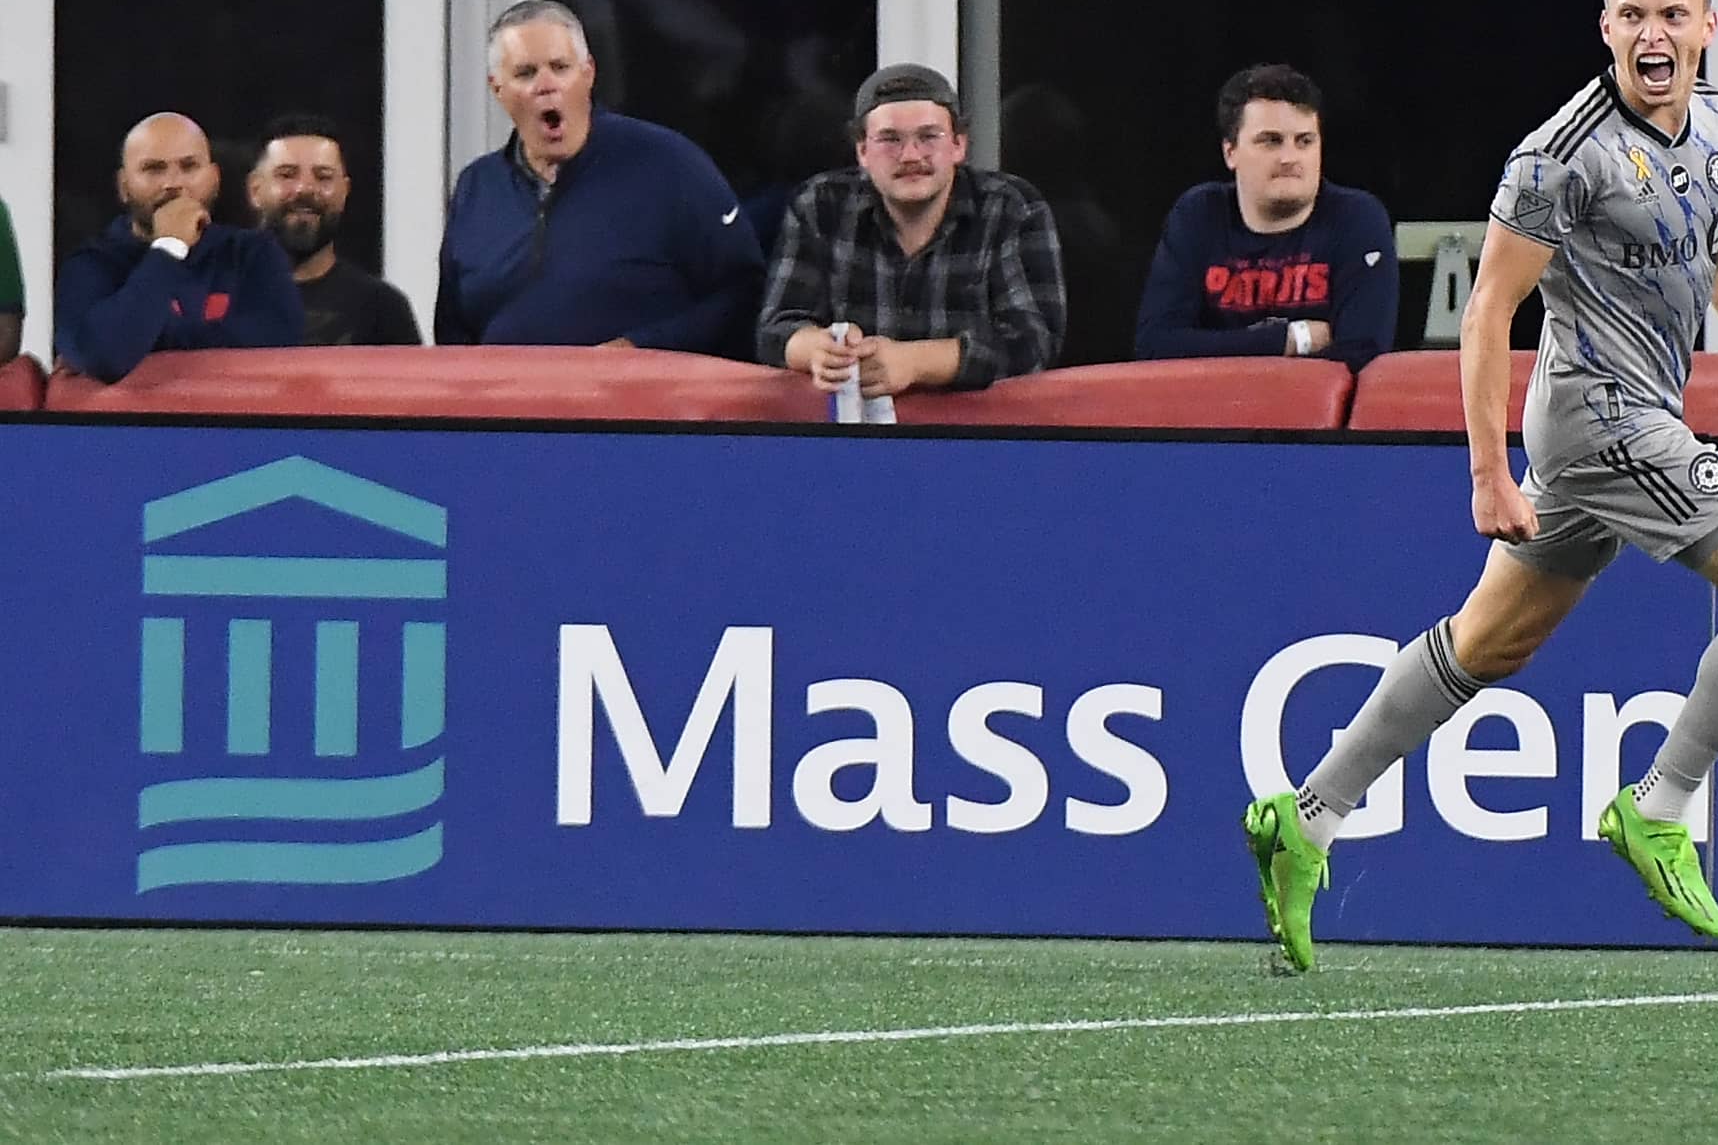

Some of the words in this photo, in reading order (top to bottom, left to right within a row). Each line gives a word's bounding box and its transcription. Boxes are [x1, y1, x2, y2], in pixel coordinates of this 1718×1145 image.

[1622, 235, 1698, 269] BMO
[1205, 262, 1329, 307] PATRITS
[557, 624, 1167, 835] Mass
